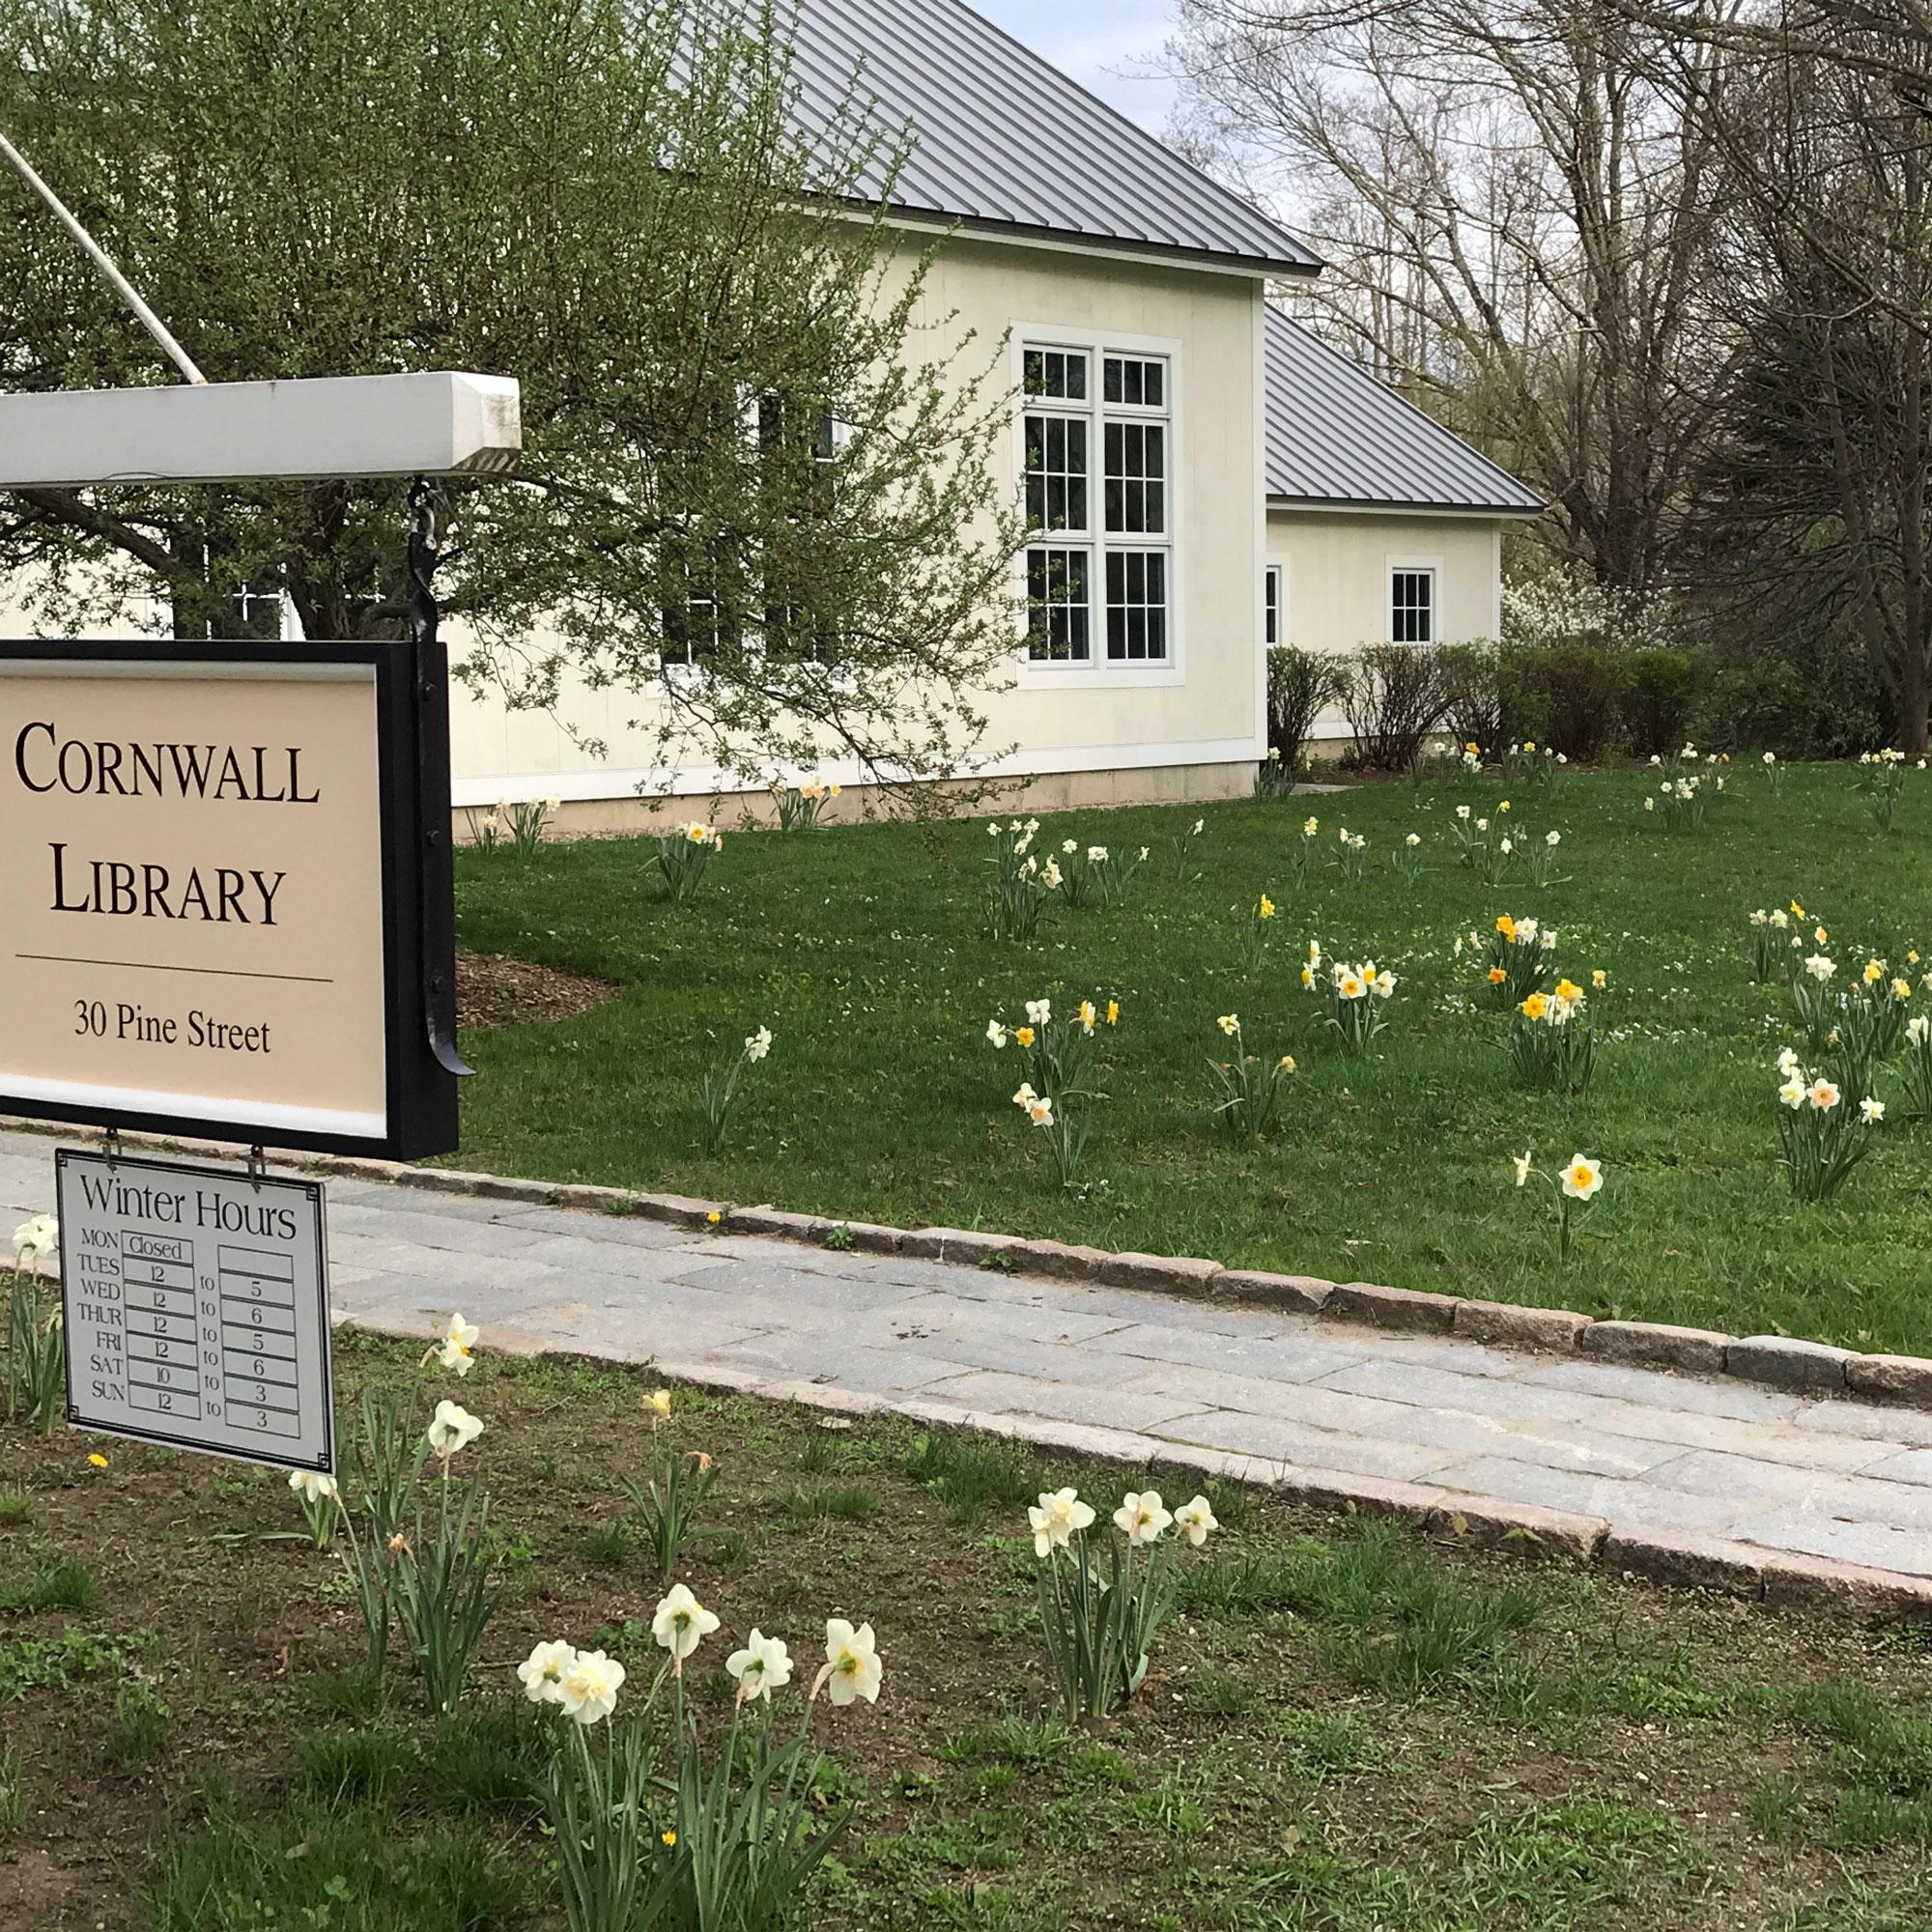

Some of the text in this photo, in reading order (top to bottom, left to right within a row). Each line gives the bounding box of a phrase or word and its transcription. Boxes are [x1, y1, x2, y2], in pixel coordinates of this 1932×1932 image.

[15, 722, 321, 803] CORNWALL
[48, 842, 286, 925] LIBRARY
[74, 1000, 270, 1053] 30 Pine Street
[80, 1175, 296, 1239] Winter Hours
[81, 1229, 182, 1259] MON Closed
[77, 1254, 261, 1296] TUES 12 to 5
[80, 1278, 262, 1323] WED 12 to 6
[77, 1303, 264, 1350] THUR 12 to 5
[97, 1331, 264, 1376] FRI 12 to 6
[91, 1354, 266, 1402] SAT 10 to 3
[93, 1381, 267, 1427] SUN 12 to 3
